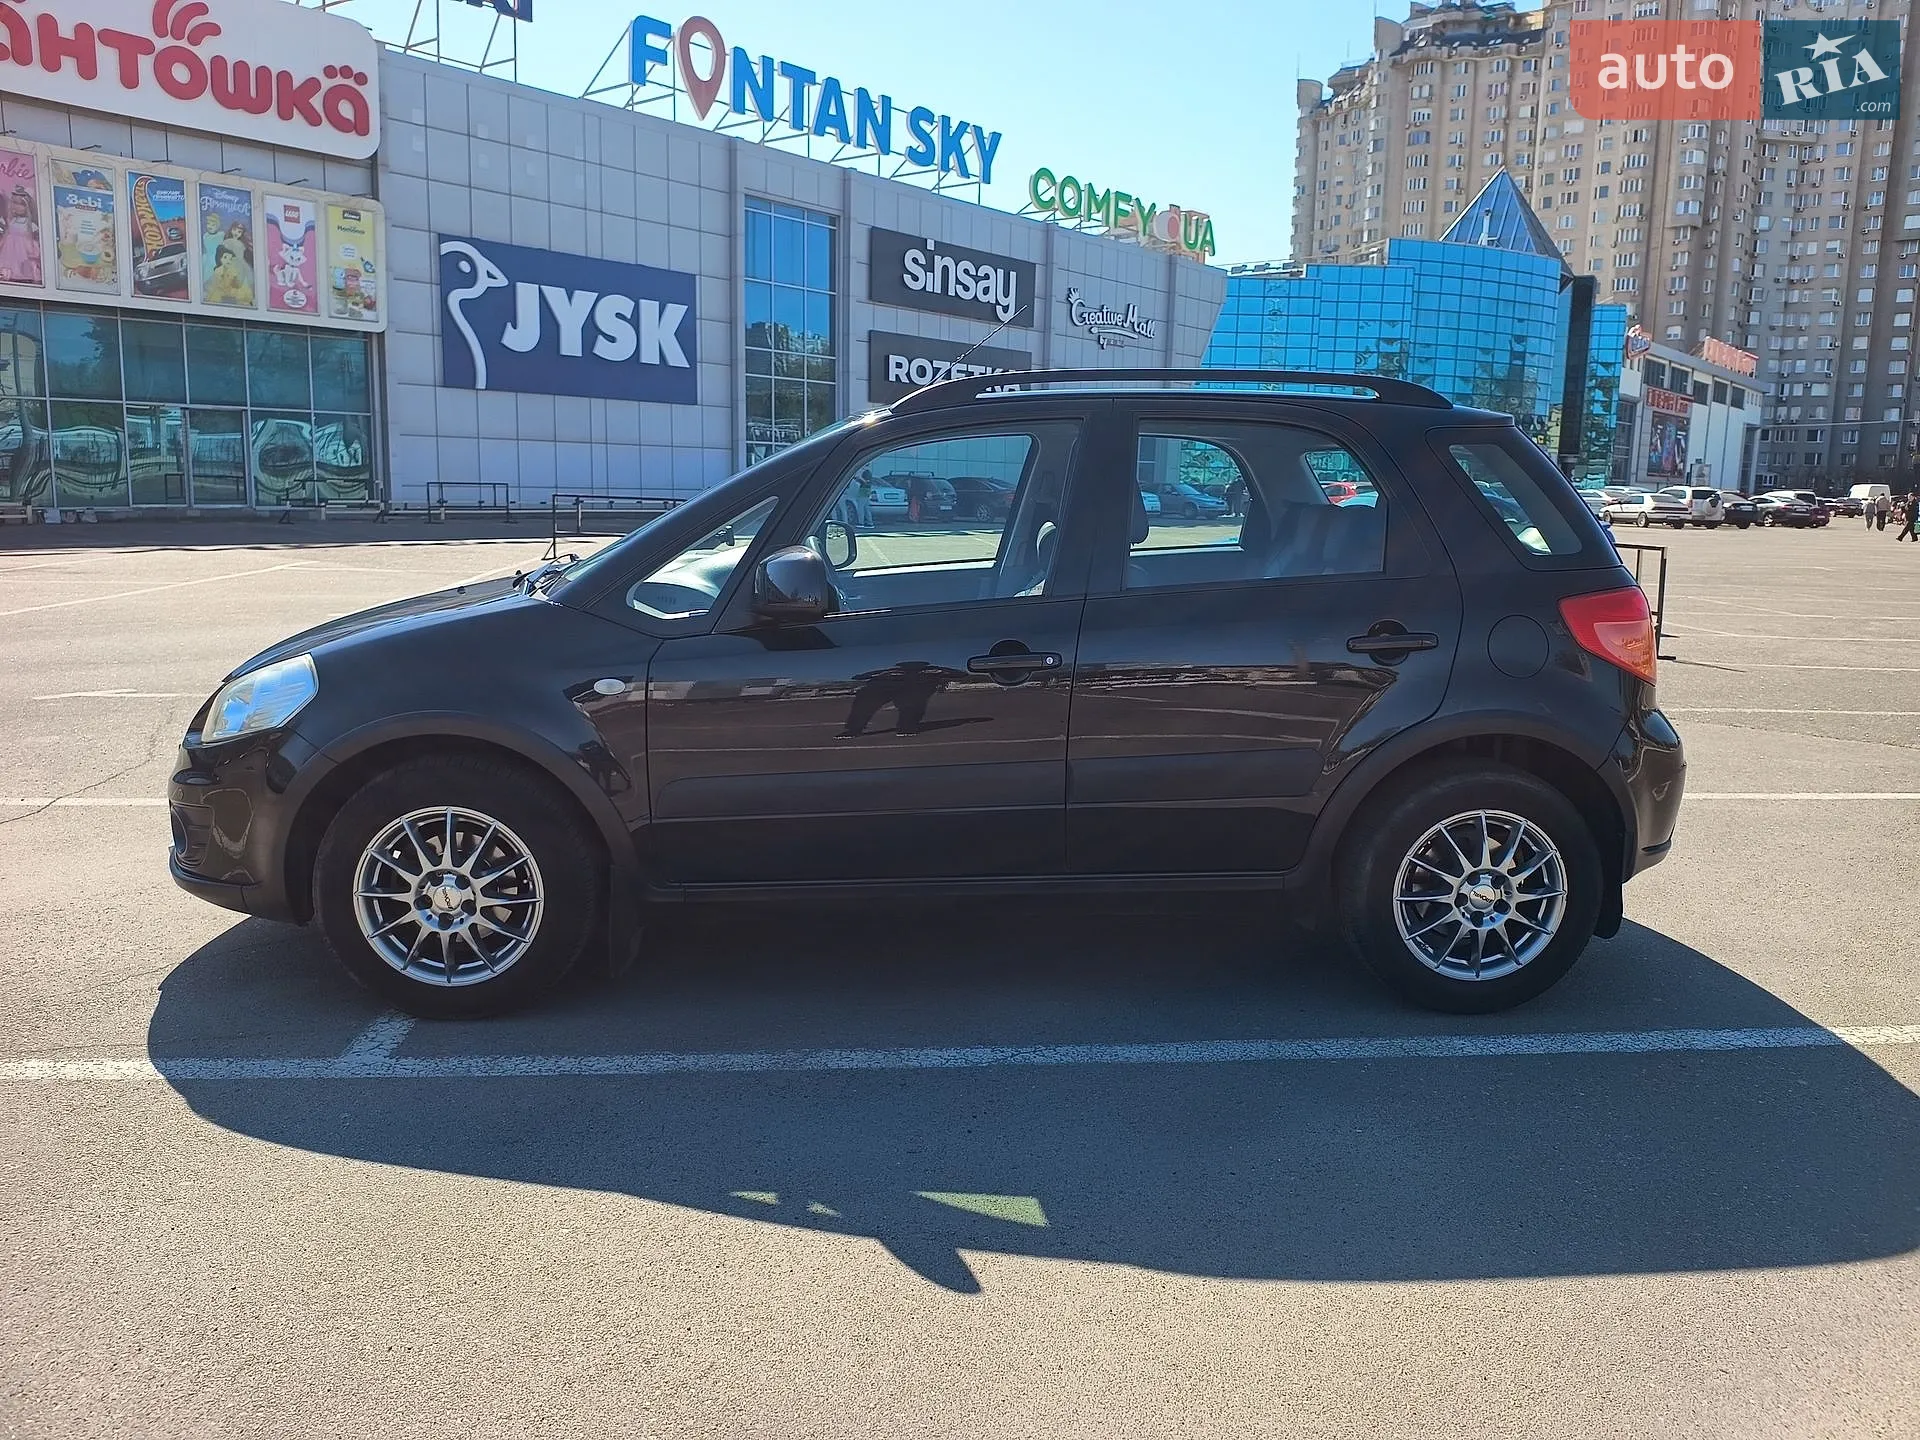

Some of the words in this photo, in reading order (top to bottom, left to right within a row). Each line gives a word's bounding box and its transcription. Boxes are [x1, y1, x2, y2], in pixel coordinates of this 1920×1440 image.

[629, 15, 891, 156] FONTAN
[904, 106, 1001, 184] SKY
[1029, 167, 1157, 237] COMFY
[903, 239, 1017, 322] sinsay
[1070, 298, 1123, 328] Creative
[1123, 303, 1155, 338] Mall
[501, 282, 690, 368] JYSK
